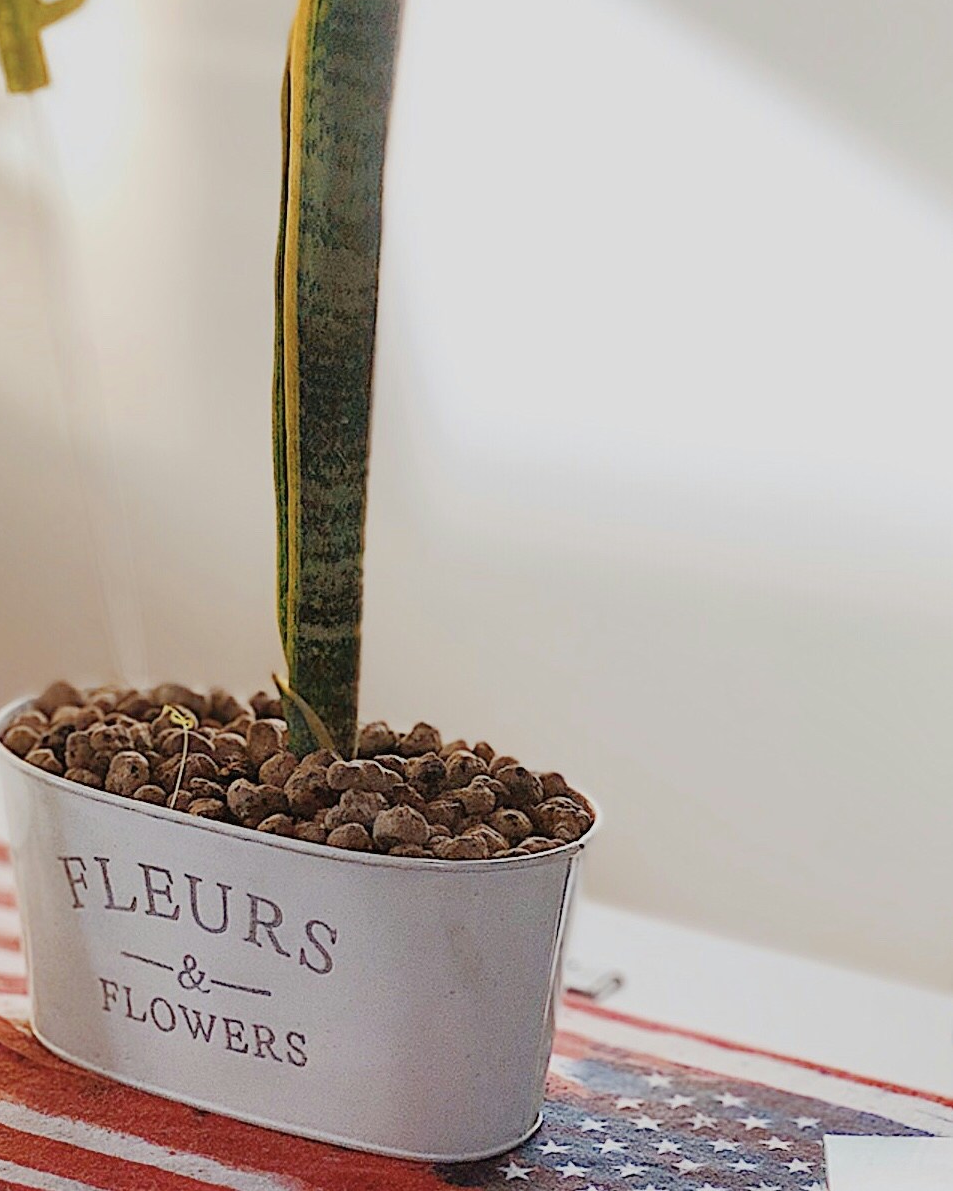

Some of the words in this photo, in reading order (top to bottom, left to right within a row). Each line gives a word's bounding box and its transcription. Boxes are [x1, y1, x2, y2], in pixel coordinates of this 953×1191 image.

[57, 855, 338, 975] FLEURS
[177, 953, 211, 995] &
[98, 977, 309, 1068] FLOWERS
